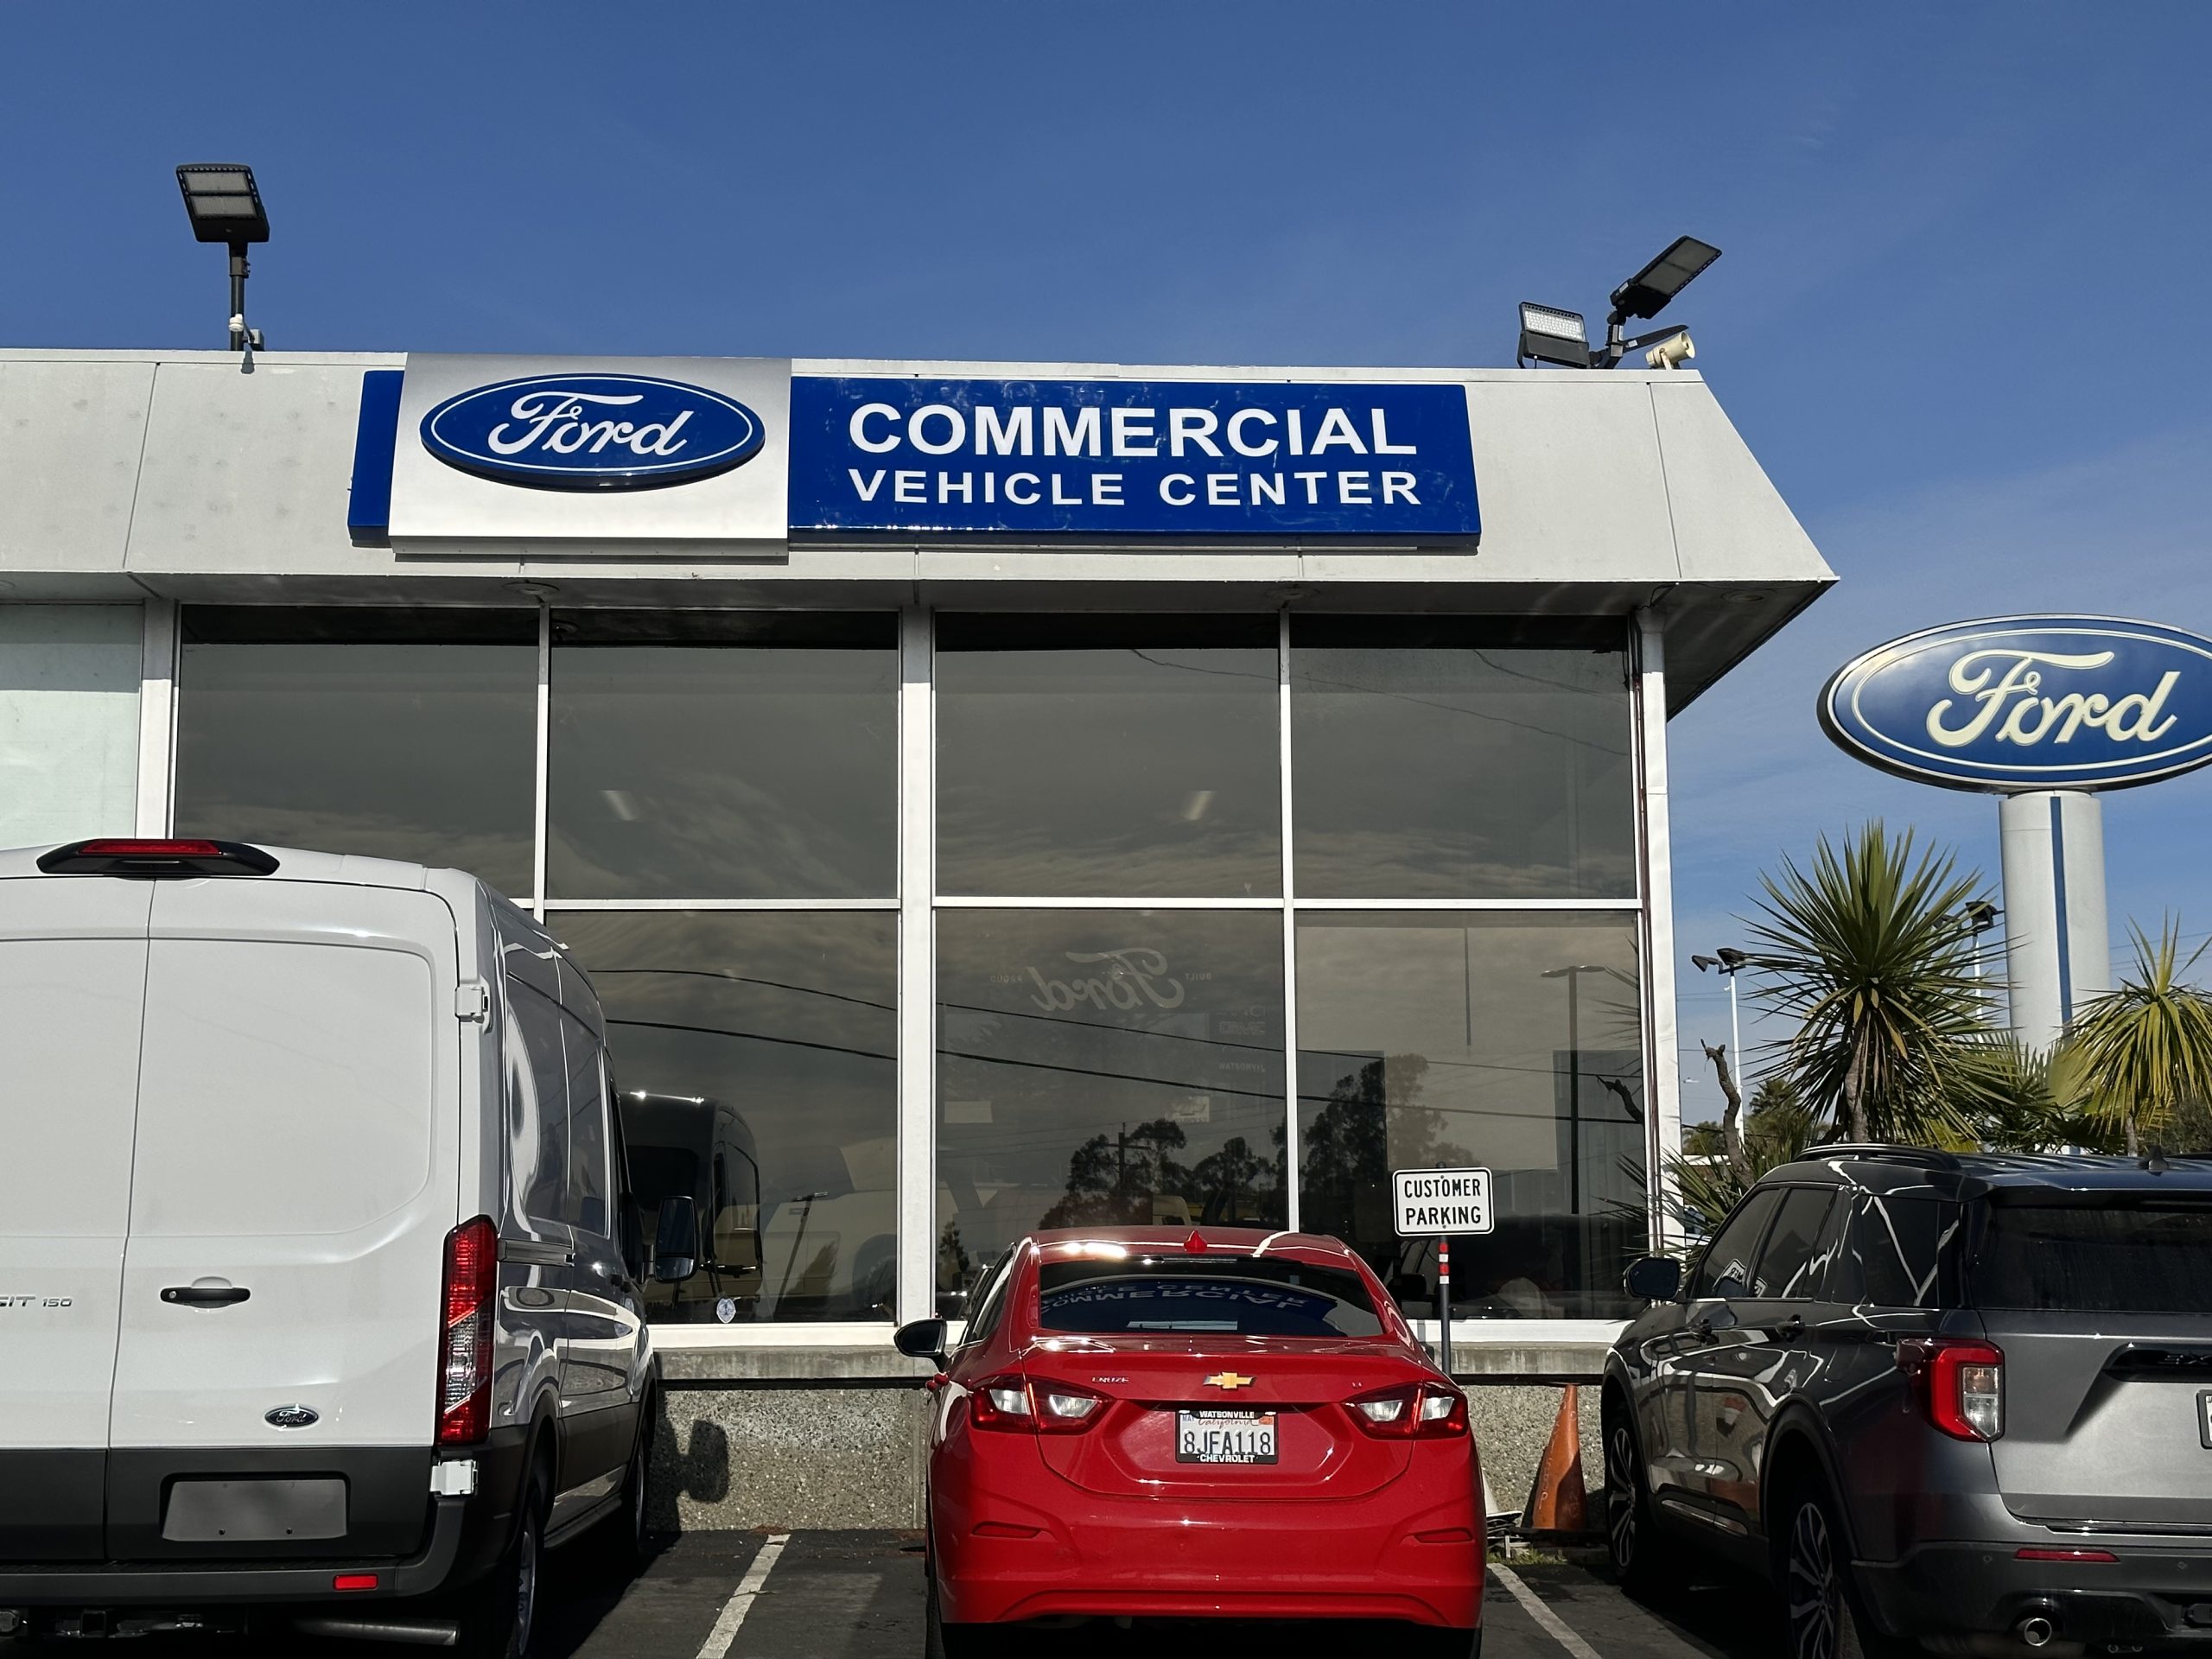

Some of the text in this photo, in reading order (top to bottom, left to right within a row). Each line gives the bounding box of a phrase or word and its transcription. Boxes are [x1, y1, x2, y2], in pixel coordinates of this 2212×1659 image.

[488, 391, 694, 457] Ford
[849, 403, 1417, 457] COMMERCIAL
[849, 469, 1421, 506] VEHICLE CENTER
[1926, 648, 2182, 747] Ford
[1404, 1179, 1481, 1198] CUSTOMER
[1405, 1205, 1481, 1225] PARKING
[42, 1298, 73, 1307] 150
[276, 1411, 308, 1423] Ford
[1198, 1410, 1255, 1419] WATSONVILLE
[1184, 1431, 1271, 1455] 8JFA118
[1199, 1453, 1255, 1463] CHEVROLET
